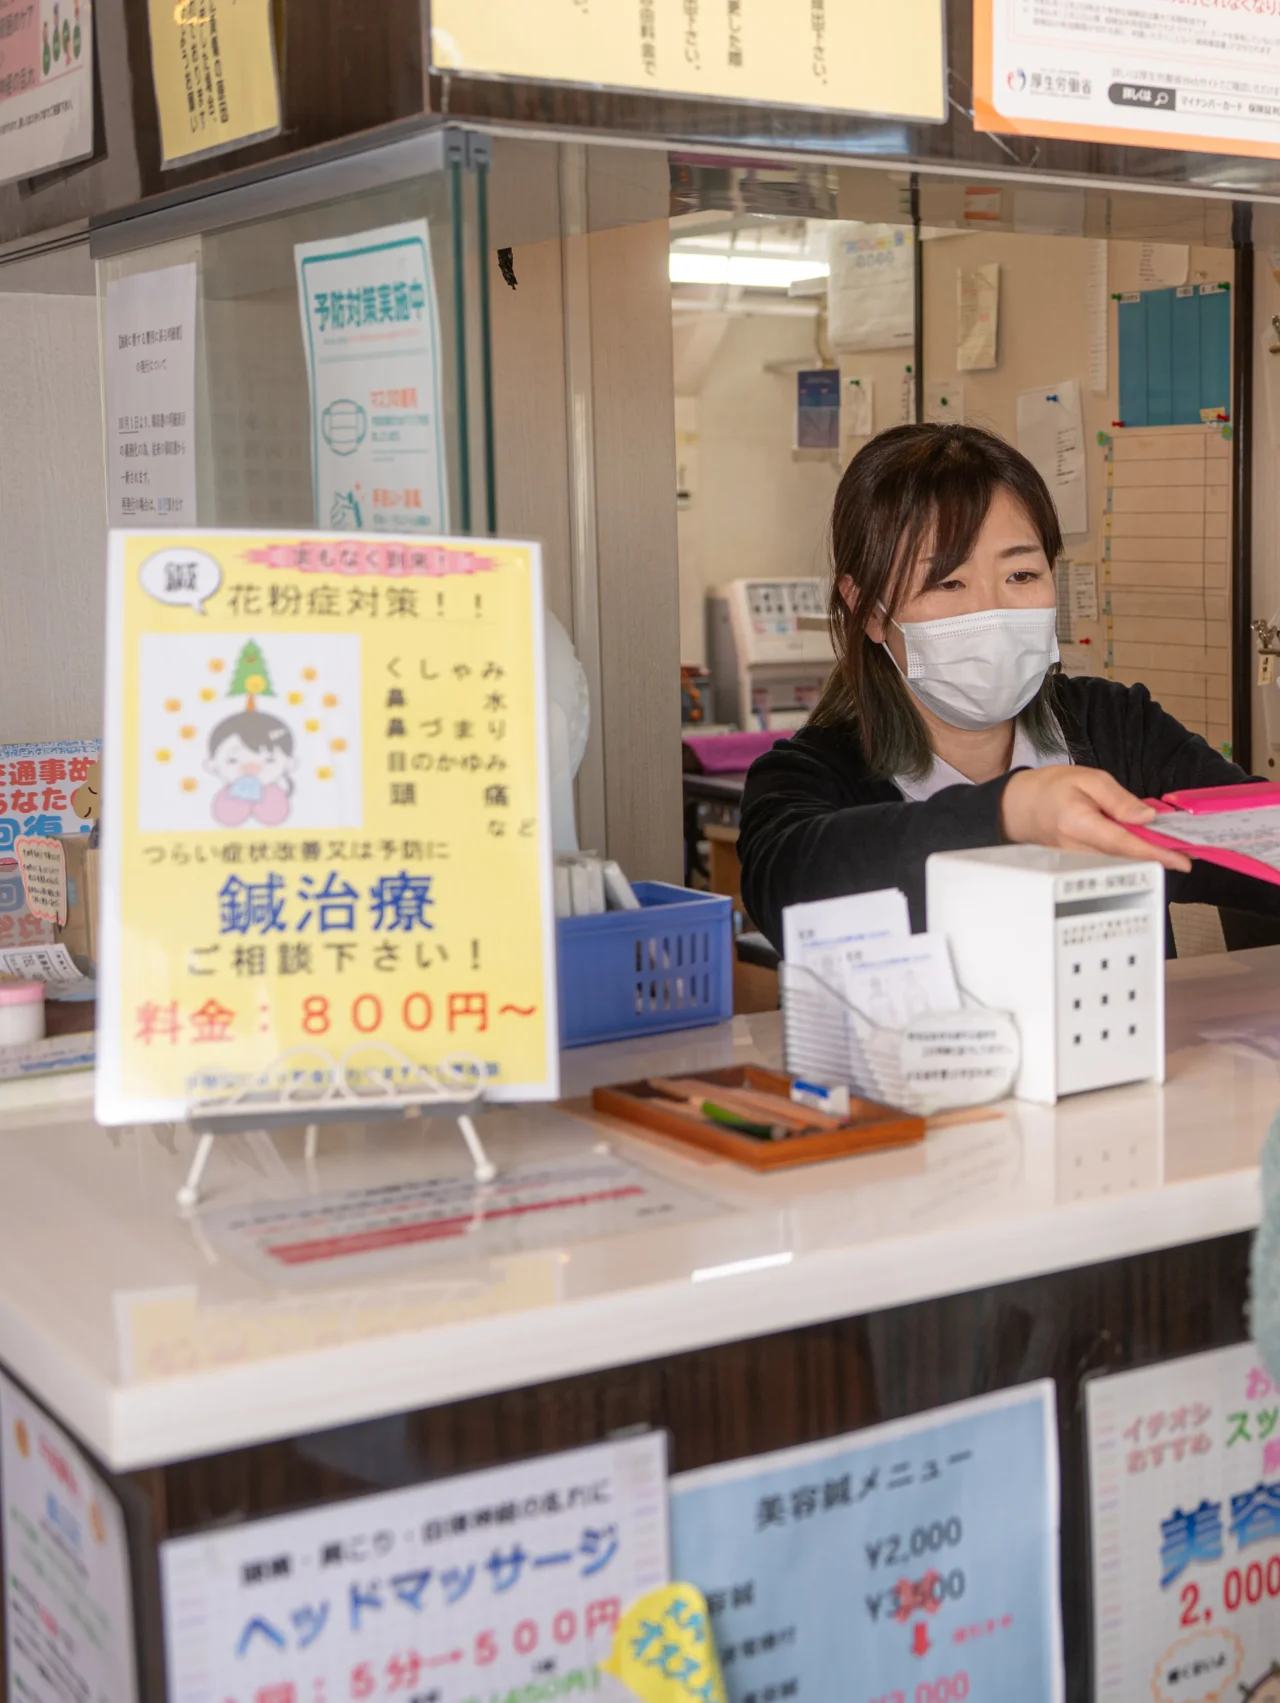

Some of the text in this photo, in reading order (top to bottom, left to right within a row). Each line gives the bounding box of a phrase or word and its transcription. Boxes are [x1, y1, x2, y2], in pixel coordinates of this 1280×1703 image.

[1030, 71, 1093, 96] 厚生労働省
[314, 281, 426, 332] 予防対策実施中
[387, 658, 506, 681] くしゃみ
[489, 819, 536, 840] など
[142, 838, 451, 865] つらい症状改善又は予防に
[218, 870, 435, 935] 鍼治療
[864, 1516, 963, 1570] ¥2,000
[235, 1523, 619, 1658] ヘッドマッサージ
